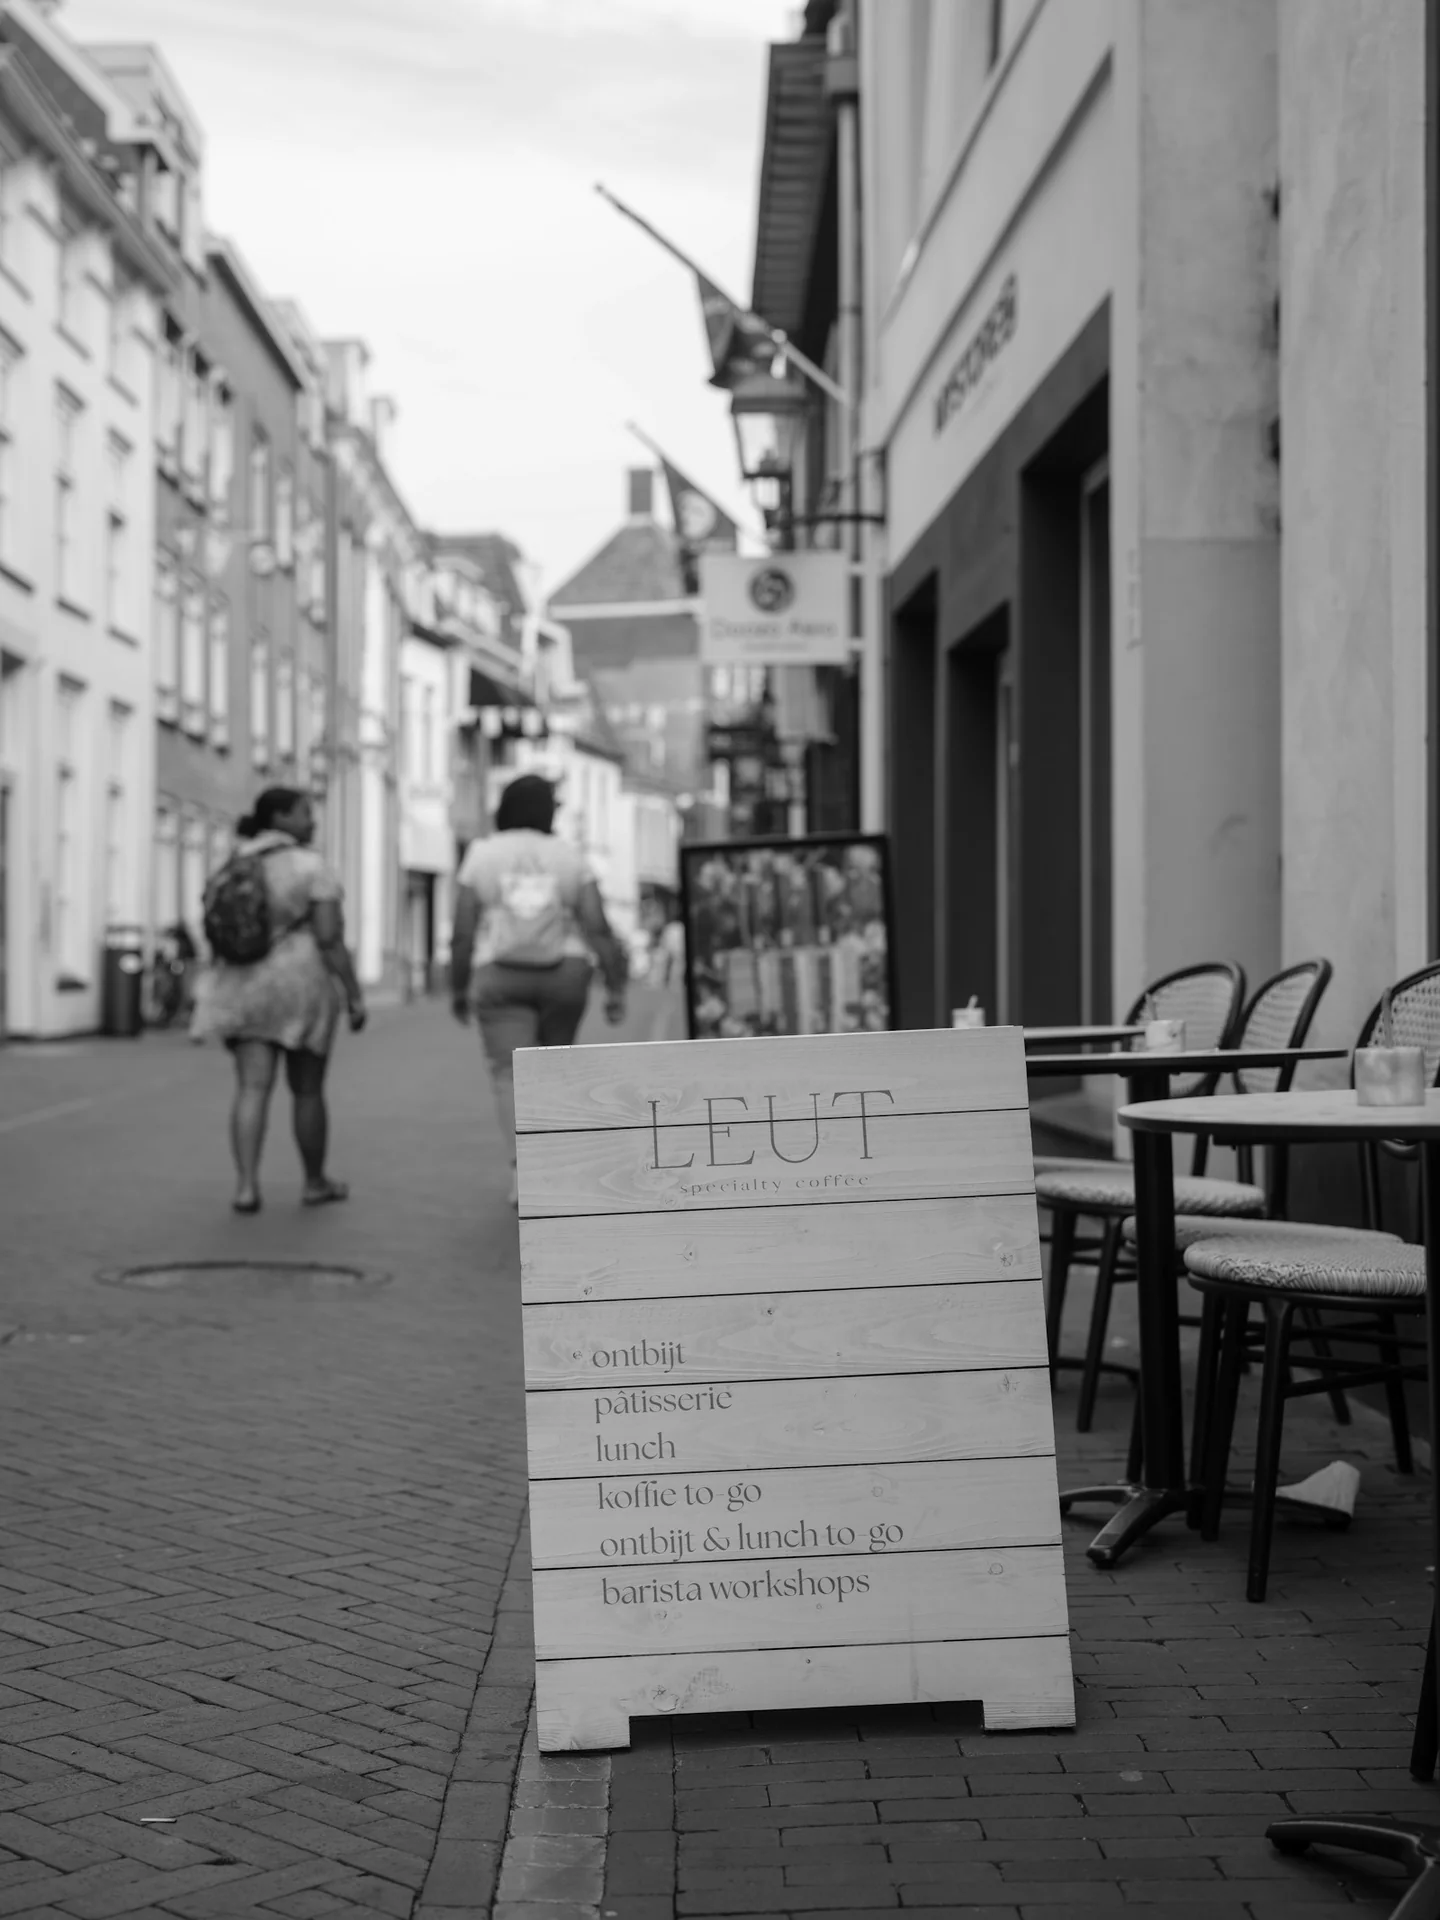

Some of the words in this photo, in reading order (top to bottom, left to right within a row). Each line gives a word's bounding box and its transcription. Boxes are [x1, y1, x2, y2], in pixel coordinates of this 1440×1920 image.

[647, 1089, 895, 1169] LEUT
[679, 1177, 783, 1197] specialty
[795, 1174, 870, 1190] coffee
[592, 1339, 687, 1373] ontbijt
[594, 1387, 733, 1424] pâtisserie
[596, 1432, 676, 1462] lunch
[598, 1480, 677, 1509] koffie
[600, 1527, 696, 1562] ontbijt
[703, 1526, 730, 1552] &
[738, 1520, 819, 1551] lunch
[601, 1577, 702, 1605] barista
[709, 1568, 870, 1603] workshops
